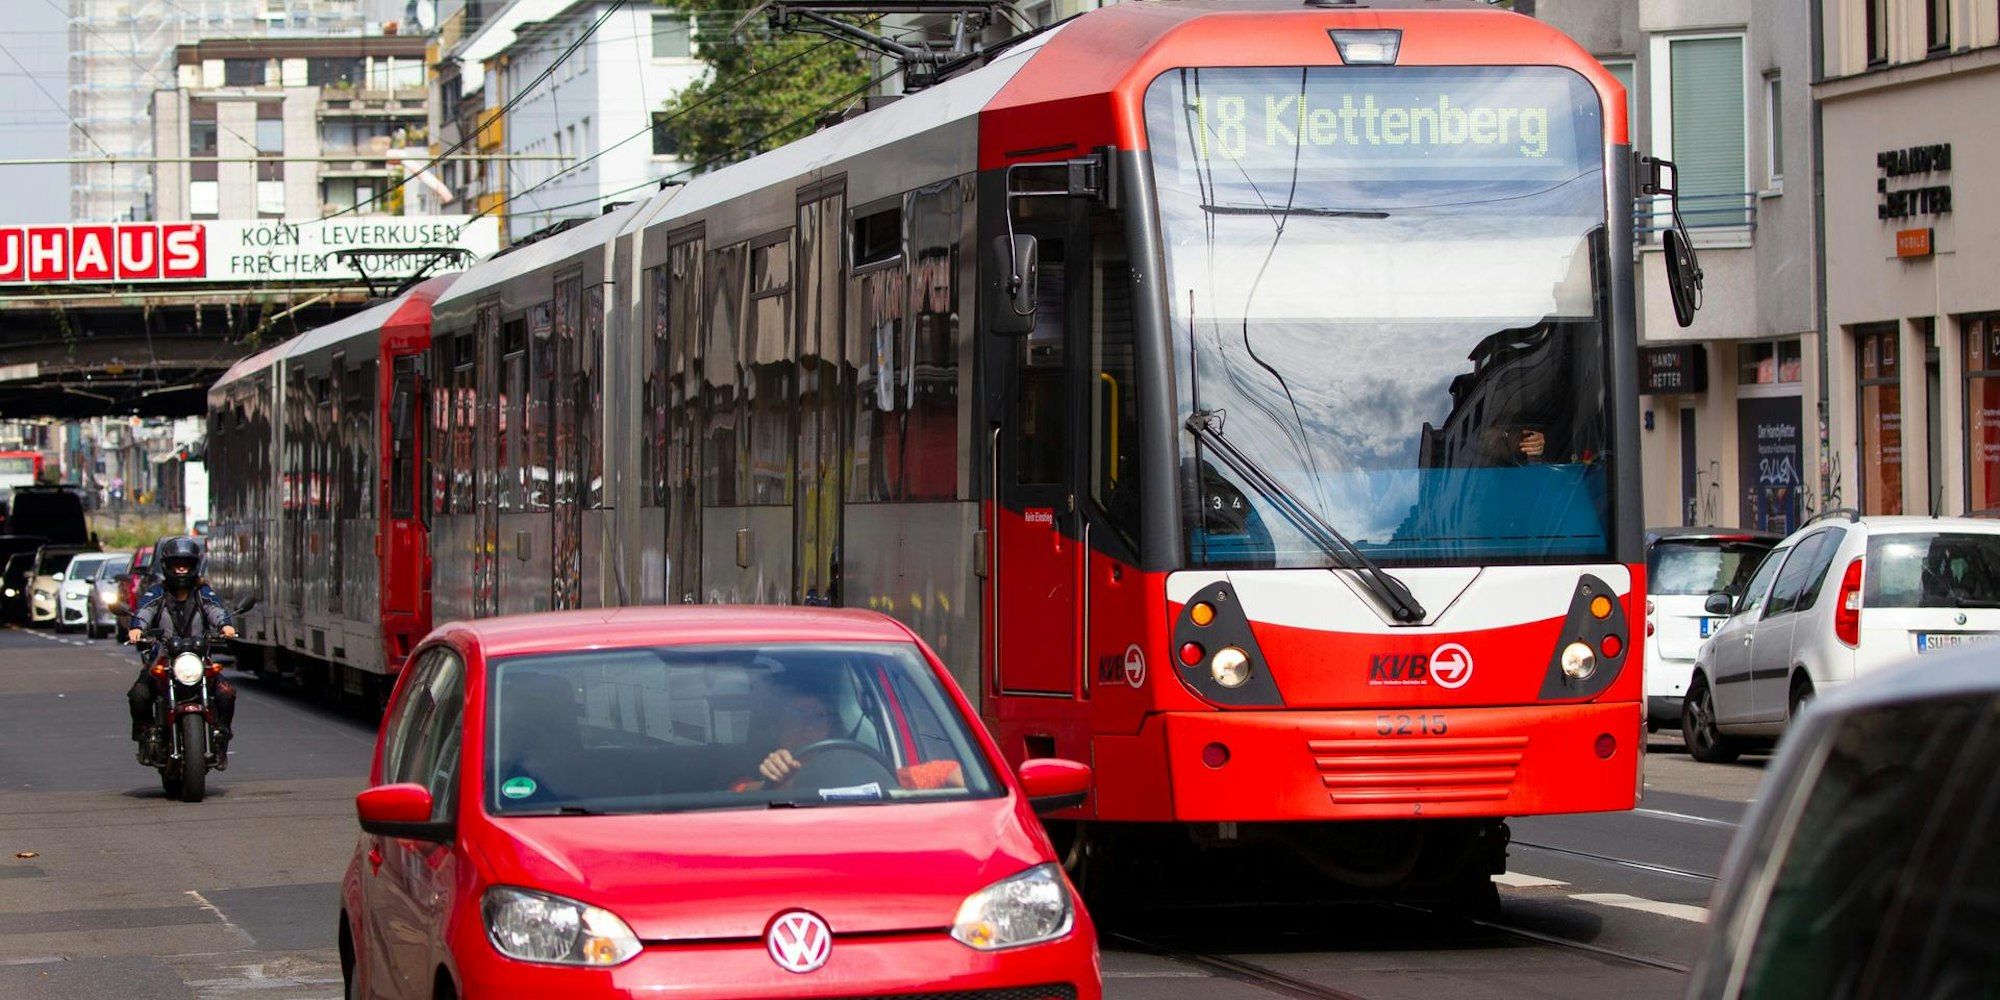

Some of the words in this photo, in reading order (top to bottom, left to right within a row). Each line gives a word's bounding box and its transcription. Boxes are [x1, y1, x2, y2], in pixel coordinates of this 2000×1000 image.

[1193, 94, 1247, 160] 18
[1265, 95, 1548, 158] Klettenberg
[241, 223, 300, 247] KÖLN
[321, 224, 461, 246] LEVERKUSEN
[231, 252, 329, 274] FRECHEN
[1652, 353, 1677, 368] HANDY
[1653, 372, 1682, 388] RETTER
[1212, 496, 1221, 510] 3
[1232, 496, 1241, 509] 4
[1928, 637, 1943, 649] SU
[1100, 654, 1125, 680] KVB
[1370, 655, 1428, 680] KVB
[1376, 714, 1447, 736] 5215
[1413, 803, 1422, 816] 2
